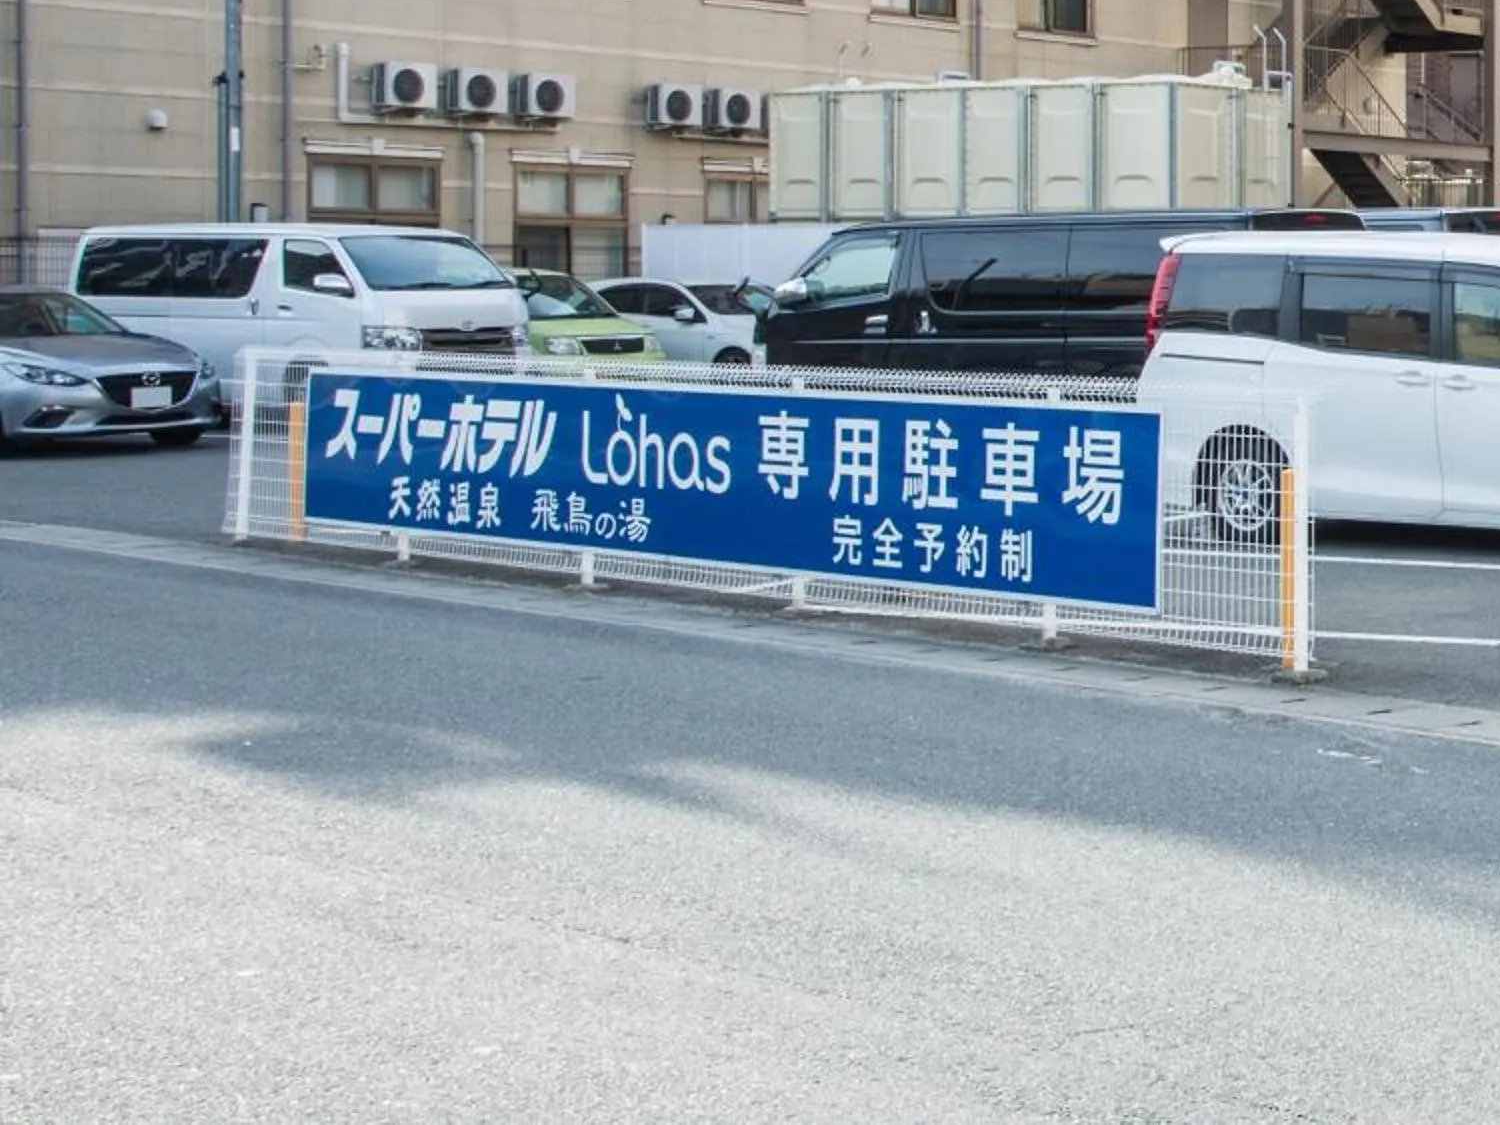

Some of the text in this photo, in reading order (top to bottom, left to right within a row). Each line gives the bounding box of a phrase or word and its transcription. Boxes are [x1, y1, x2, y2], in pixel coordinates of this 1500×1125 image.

[325, 388, 1124, 525] スーパーホテル Lohas 専用駐車場
[389, 476, 651, 542] 天然温泉 飛鳥の湯
[833, 514, 1032, 582] 完全予約制
